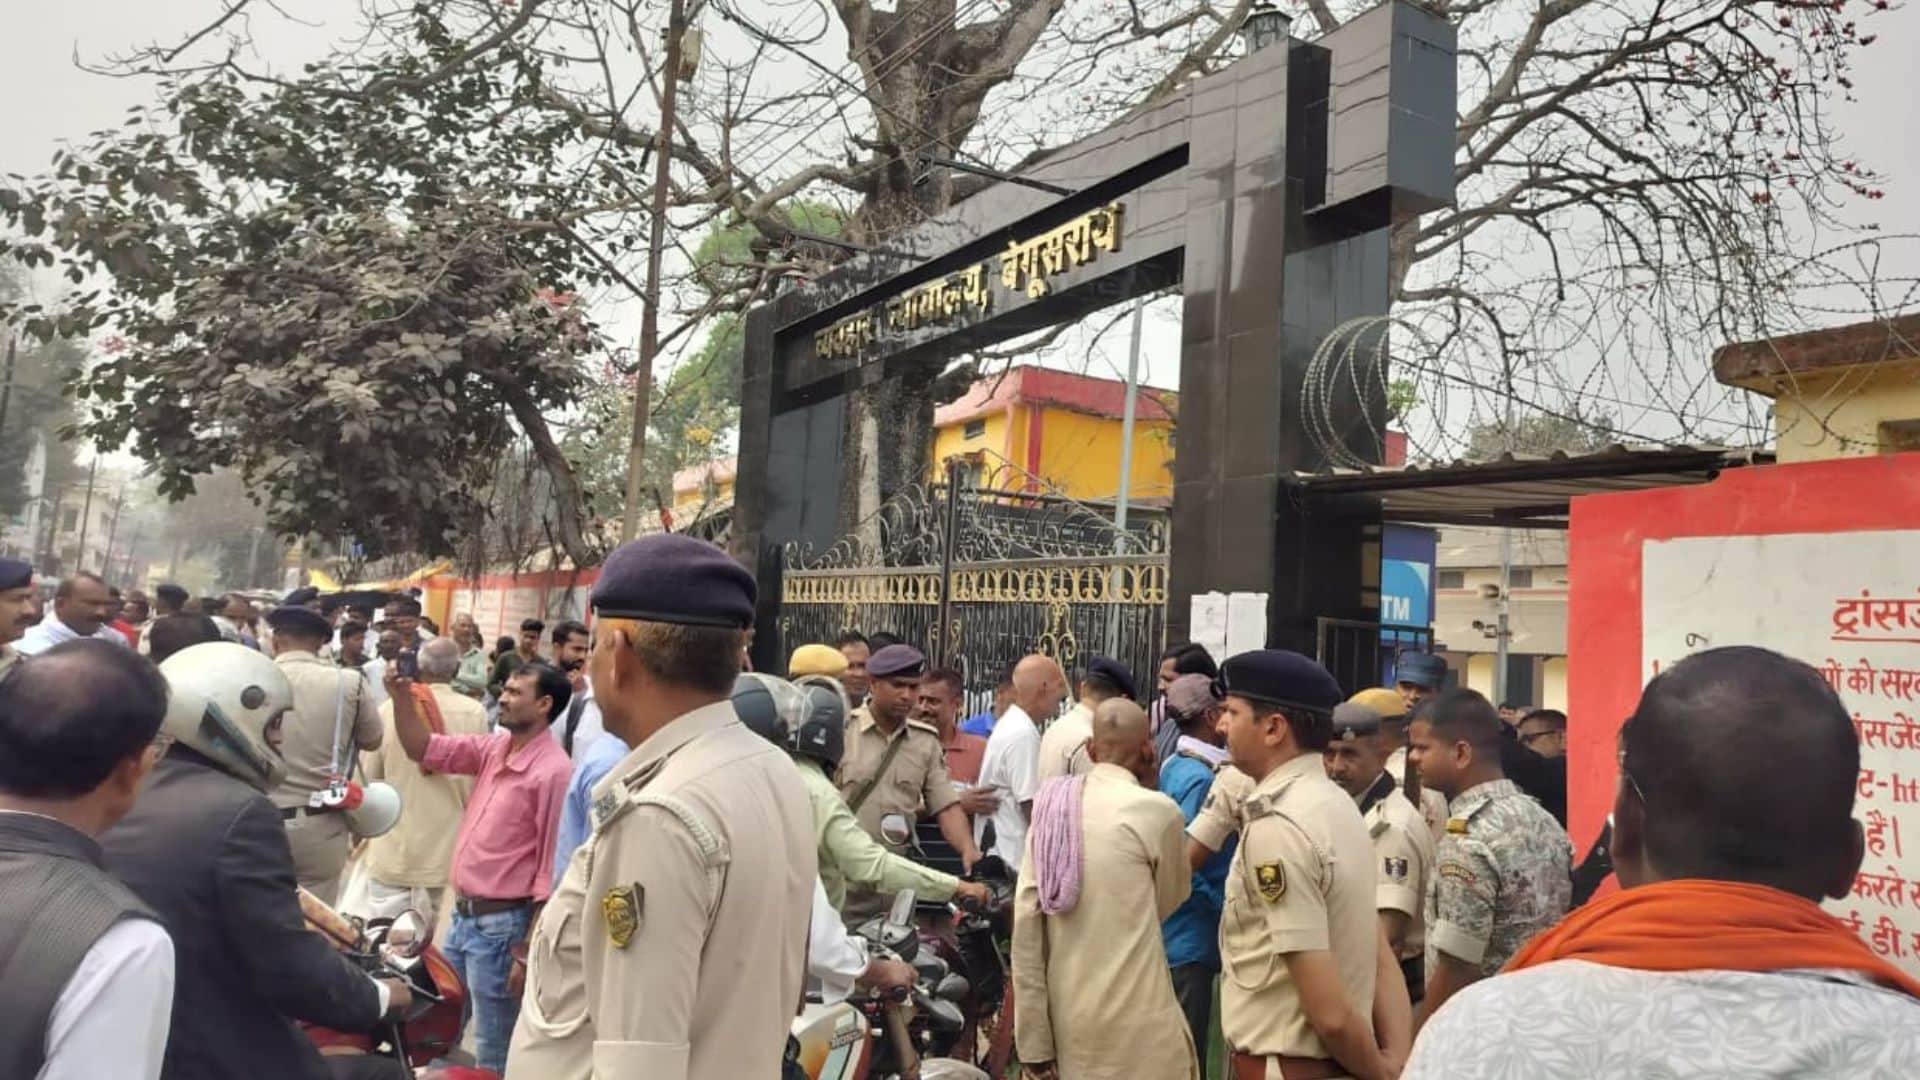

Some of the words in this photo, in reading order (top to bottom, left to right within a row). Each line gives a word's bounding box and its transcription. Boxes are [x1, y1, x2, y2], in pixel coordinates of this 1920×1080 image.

[1000, 201, 1120, 298] बेगूसराय
[1381, 595, 1410, 620] TM
[1848, 657, 1878, 694] को
